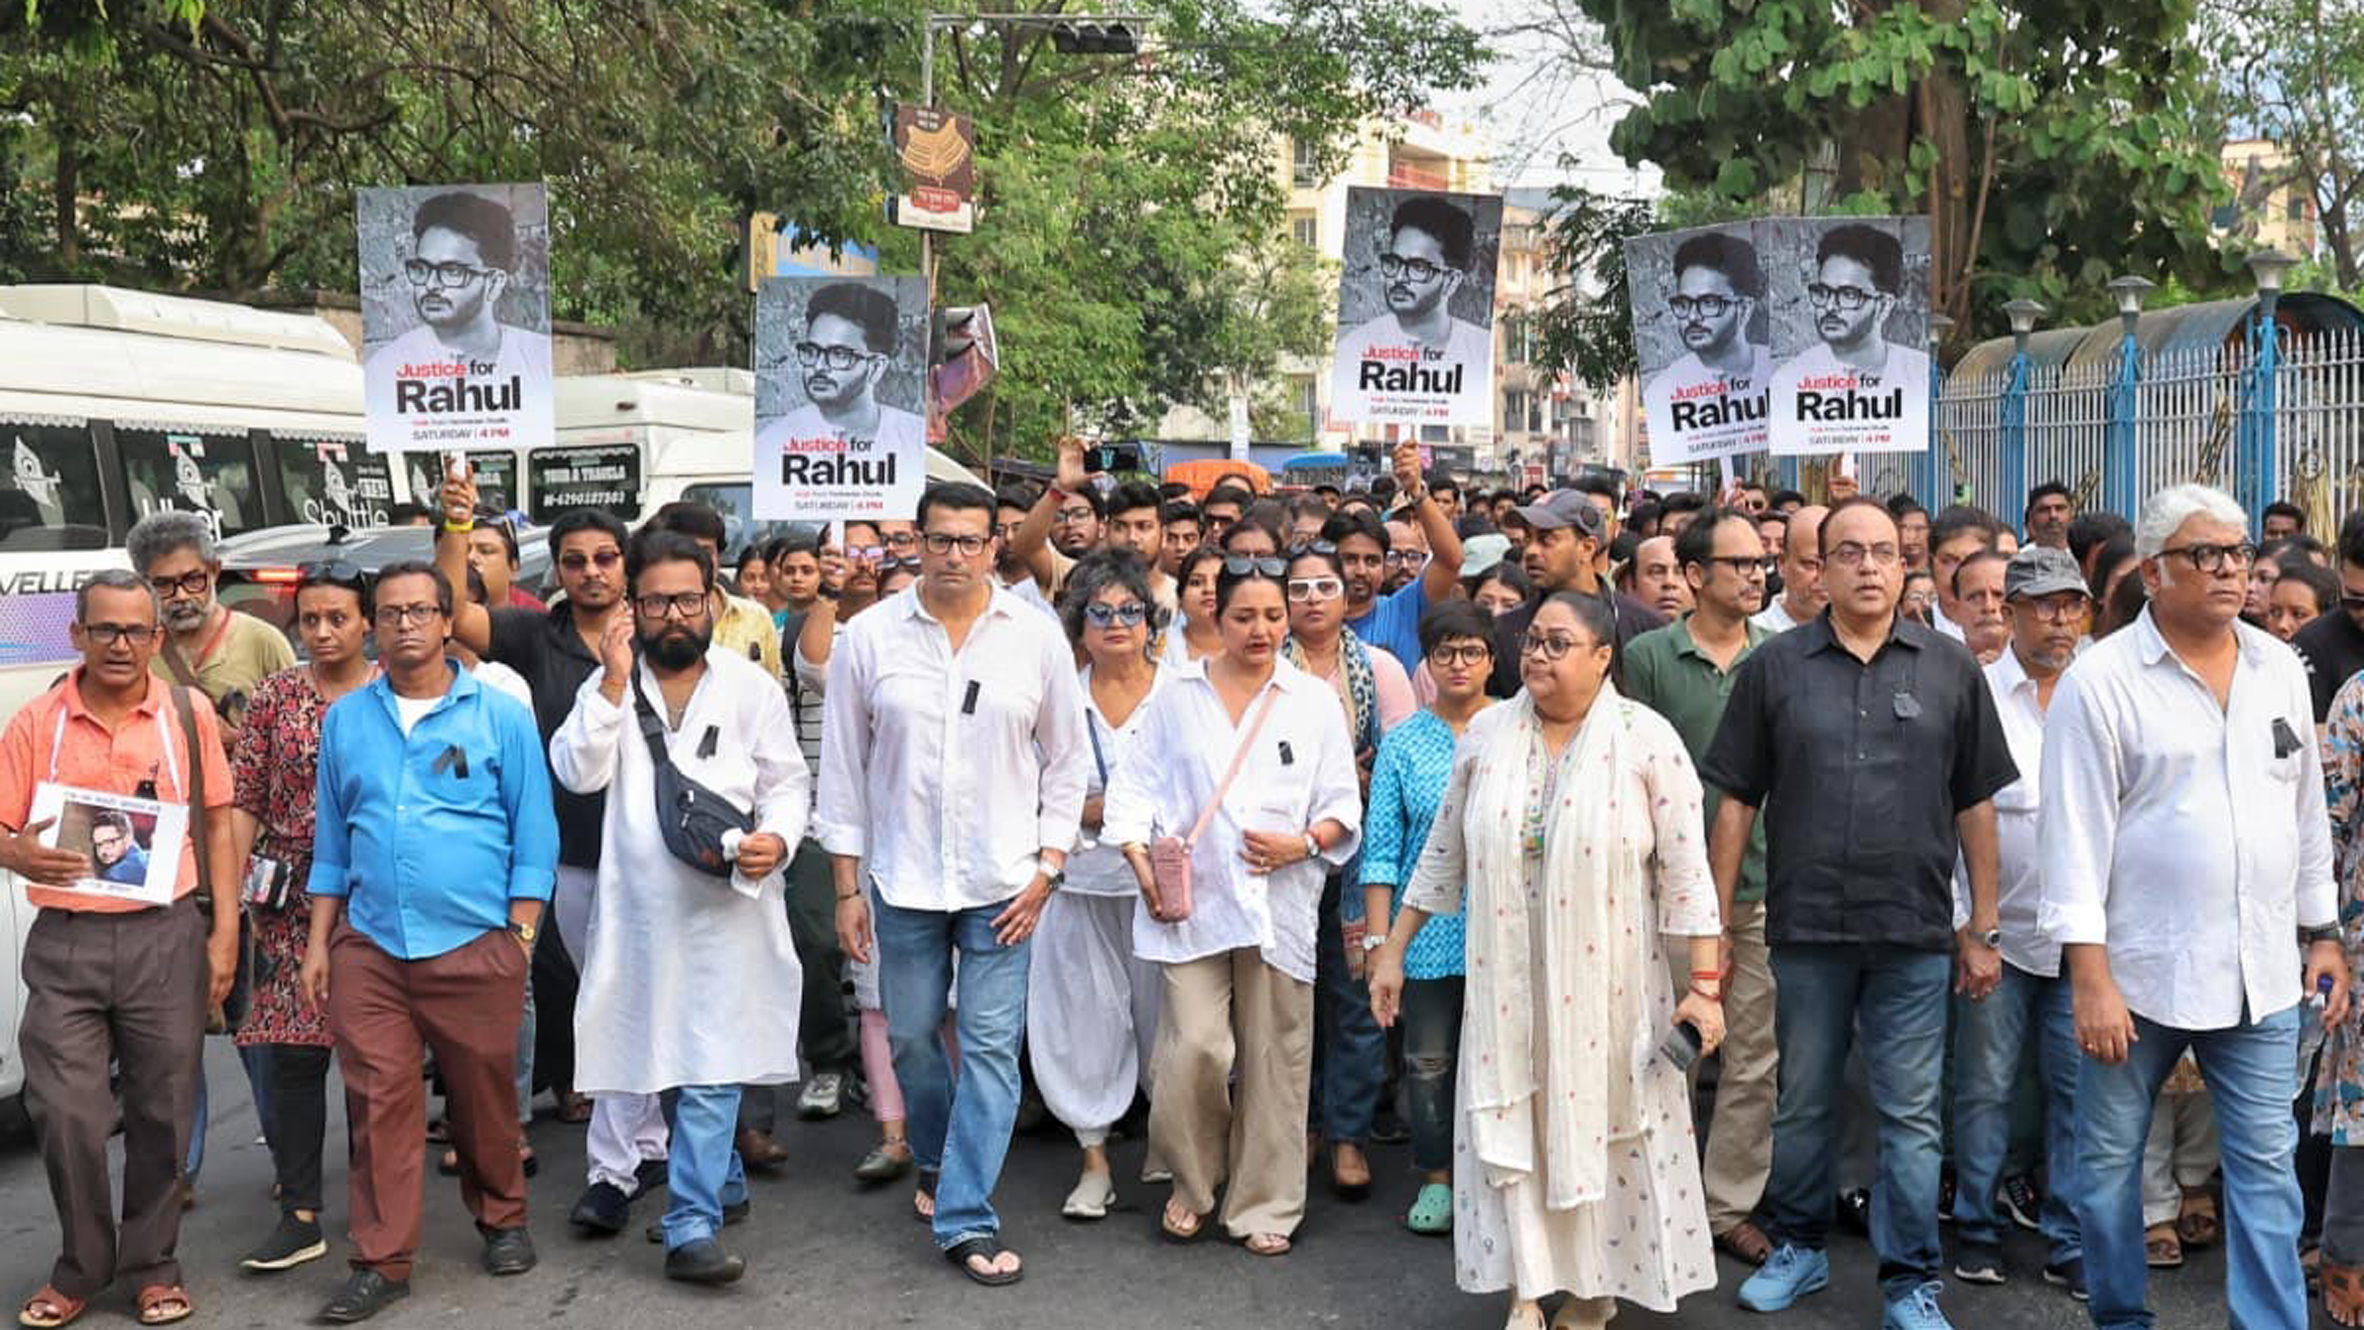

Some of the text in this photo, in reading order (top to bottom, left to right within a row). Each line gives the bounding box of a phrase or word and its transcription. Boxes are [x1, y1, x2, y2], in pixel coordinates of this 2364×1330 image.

[1362, 345, 1445, 361] Justice for
[396, 359, 495, 378] Justice for
[1359, 361, 1463, 394] Rahul
[1797, 374, 1881, 389] Justice for
[396, 375, 521, 413] Rahul
[1670, 378, 1751, 400] Justice for
[1371, 406, 1418, 416] SATURDAY
[1433, 408, 1449, 416] PM
[1797, 388, 1902, 421] Rahul
[413, 429, 472, 440] SATURDAY
[490, 428, 509, 438] PM
[1688, 439, 1736, 453] SATURDAY
[1751, 432, 1766, 443] PM
[1809, 436, 1858, 444] SATURDAY
[1874, 434, 1891, 443] PM
[784, 437, 875, 452] Justice for
[782, 453, 896, 485] Rahul
[795, 502, 849, 510] SATURDAY
[866, 502, 883, 510] PM
